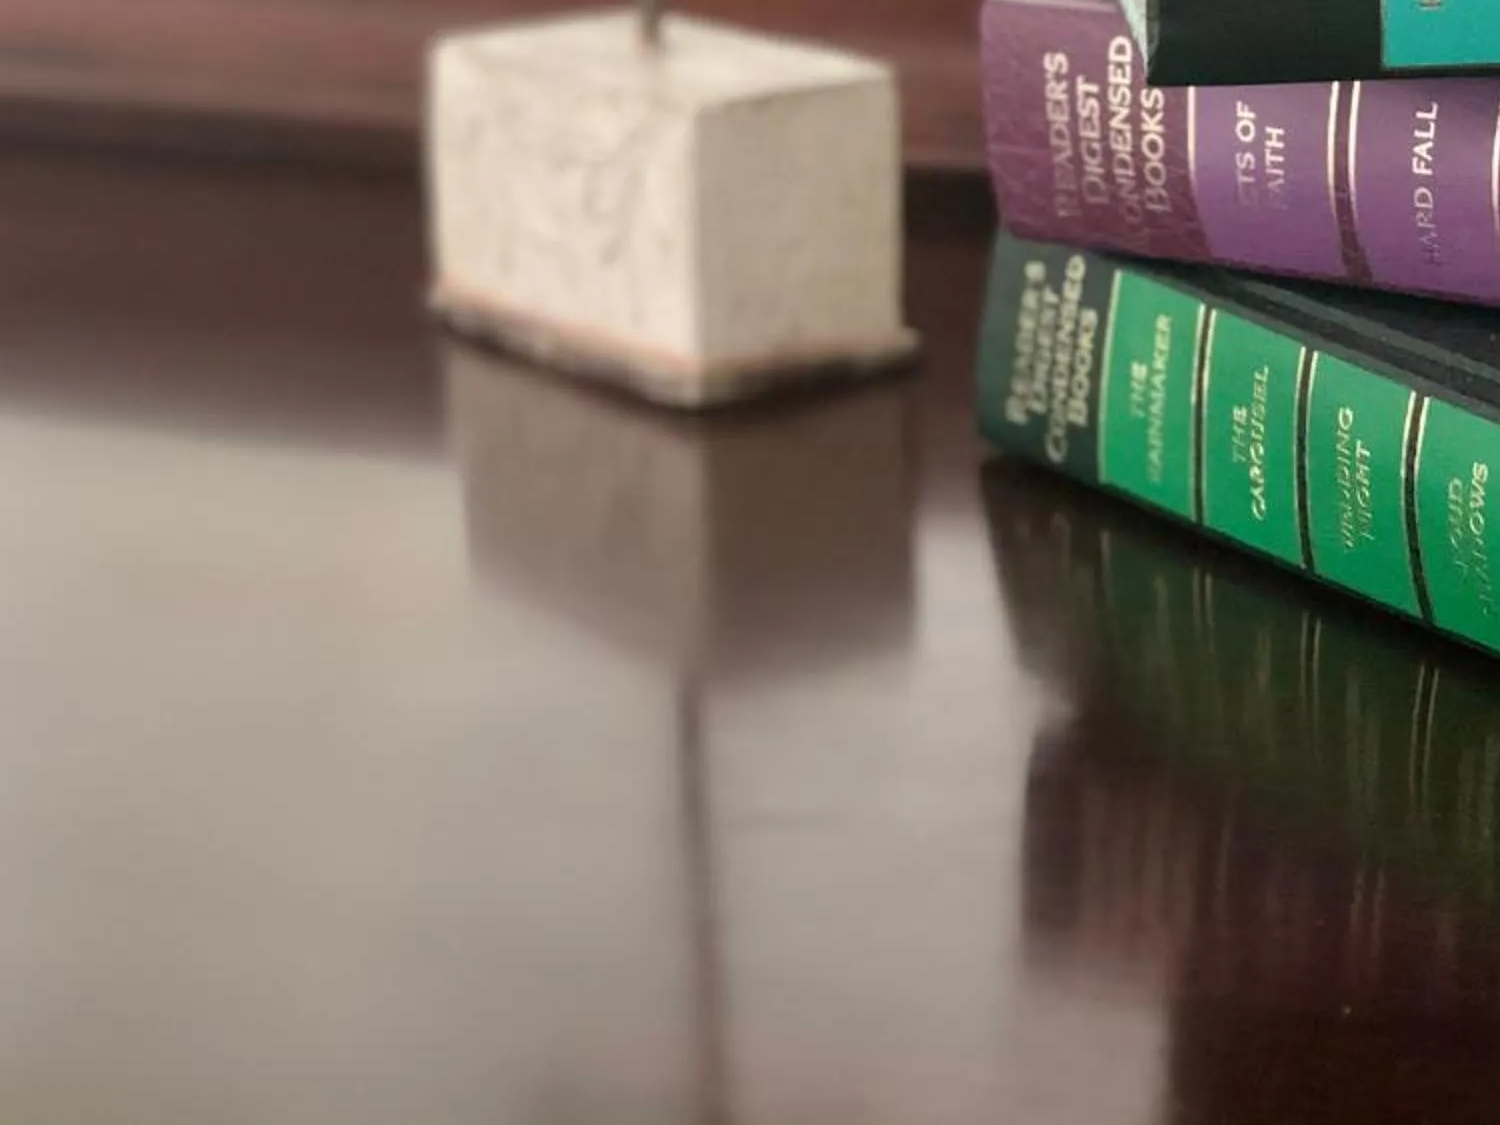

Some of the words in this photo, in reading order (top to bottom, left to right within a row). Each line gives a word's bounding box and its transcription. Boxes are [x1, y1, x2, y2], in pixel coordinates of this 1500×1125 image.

[1043, 51, 1071, 219] READER'S
[1075, 75, 1110, 205] DIGEST
[1108, 35, 1141, 227] ONDENSED
[1140, 87, 1171, 215] BOOKS
[1234, 100, 1258, 143] OF
[1411, 102, 1439, 175] FALL
[1066, 307, 1098, 427] BOOKS
[1231, 405, 1248, 463] THE
[1248, 365, 1270, 521] CAROUSEL
